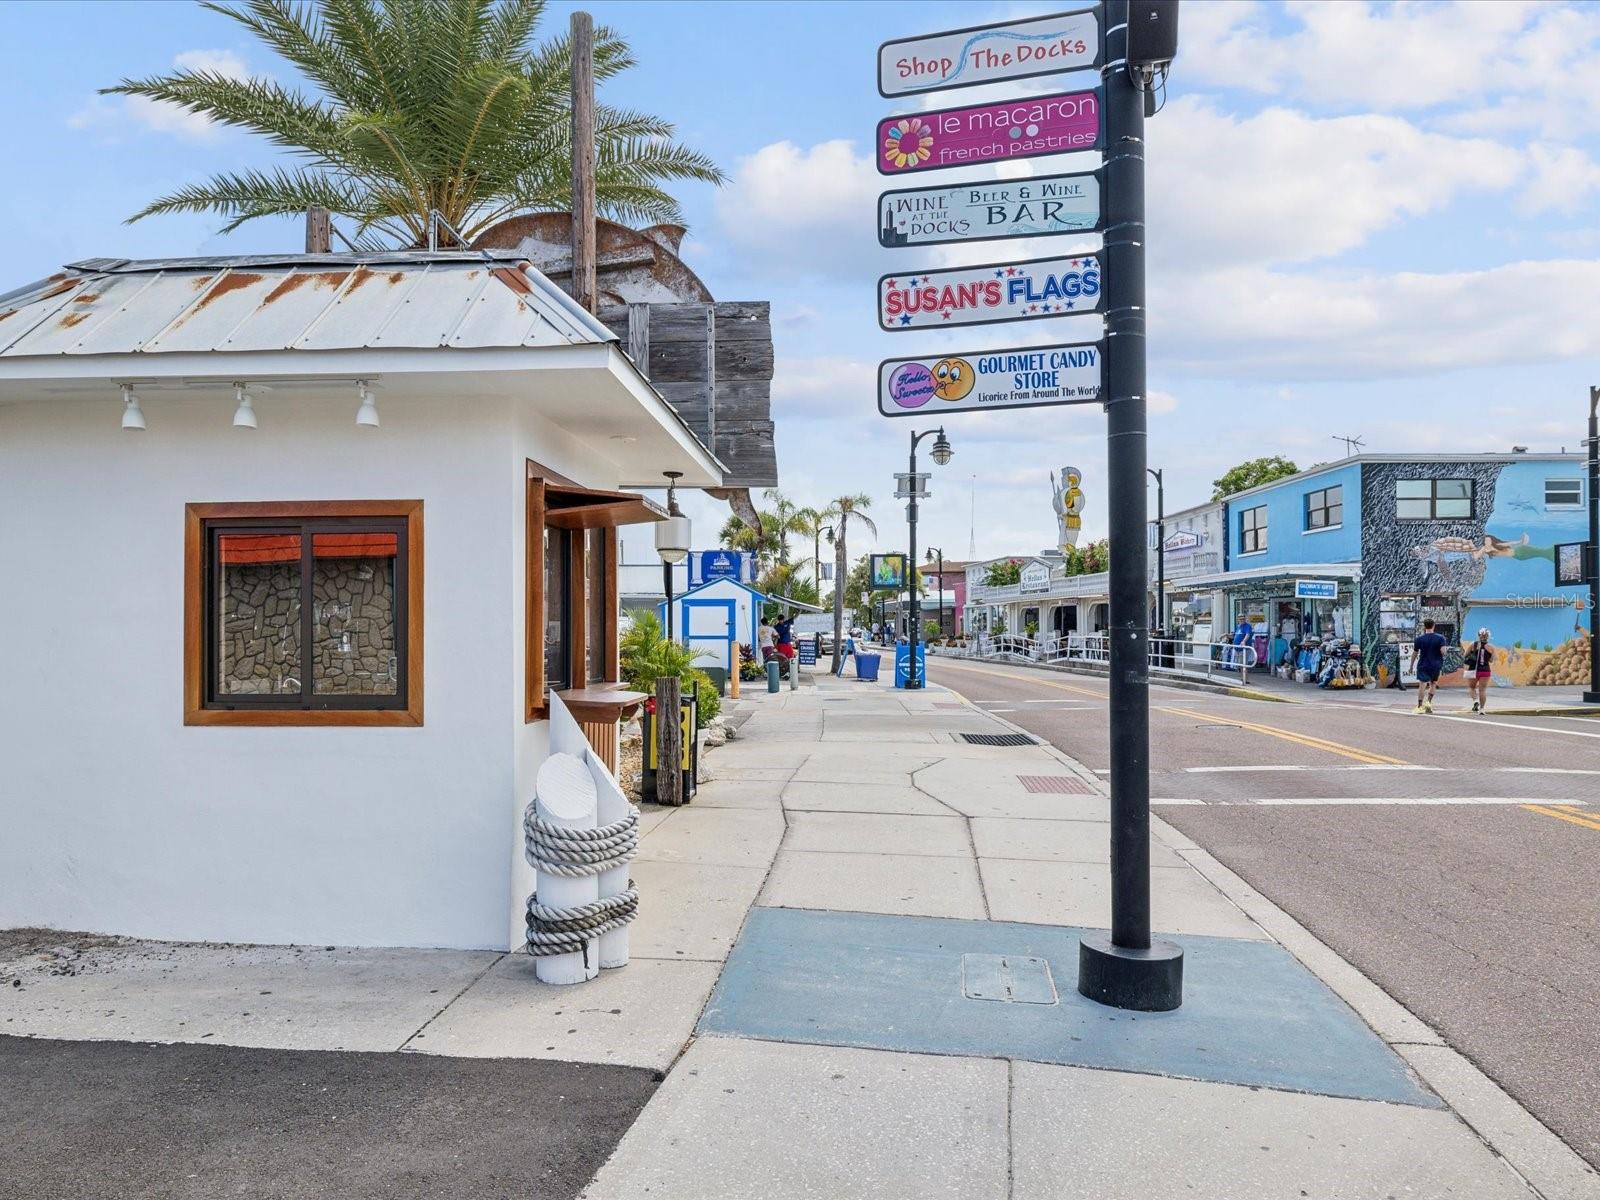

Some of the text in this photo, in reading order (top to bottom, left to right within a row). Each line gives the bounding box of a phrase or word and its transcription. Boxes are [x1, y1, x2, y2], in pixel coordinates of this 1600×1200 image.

[896, 39, 1086, 78] Shop The Docks
[938, 98, 1095, 134] le macaron
[939, 131, 1096, 164] french pastries
[1019, 186, 1031, 199] &
[897, 196, 949, 213] WINE
[986, 201, 1083, 226] BAR
[911, 211, 949, 222] AT THE
[911, 219, 971, 236] DOCKS
[885, 270, 1100, 316] SUSAN'S FLAGS
[978, 350, 1097, 374] GOURMET CANDY
[1014, 371, 1061, 390] STORE
[978, 386, 1101, 402] Licorice From Around The World
